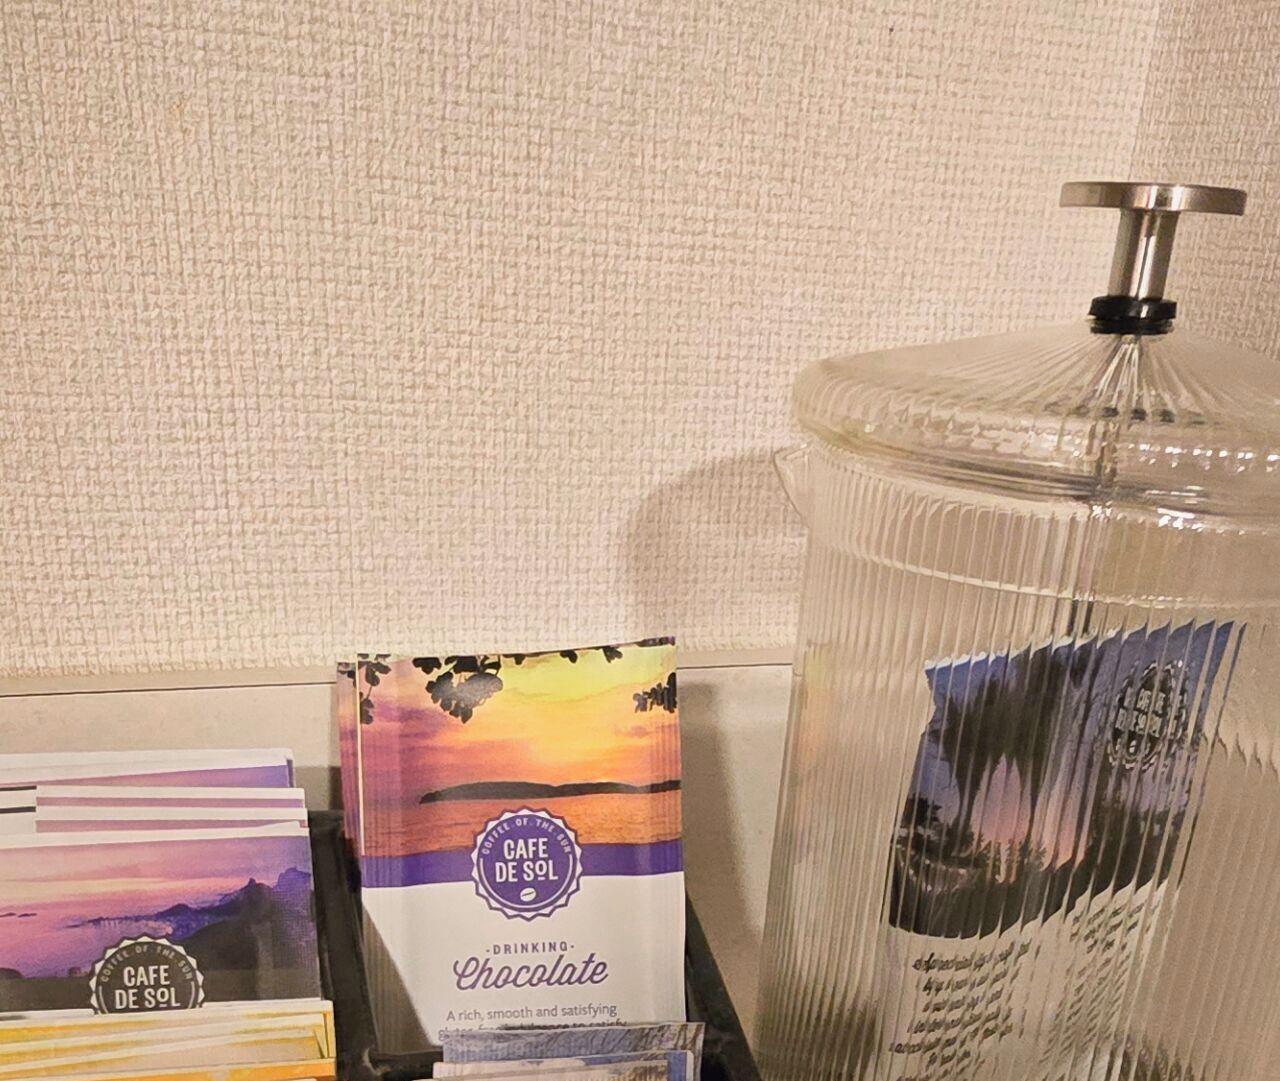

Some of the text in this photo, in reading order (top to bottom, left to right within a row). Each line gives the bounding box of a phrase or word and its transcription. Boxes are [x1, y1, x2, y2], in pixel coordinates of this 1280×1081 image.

[515, 818, 529, 827] OF
[535, 818, 555, 832] THE
[503, 837, 548, 860] CAFE
[495, 859, 558, 883] DE SOL
[123, 965, 171, 987] CAFE
[453, 952, 609, 991] Chocolate
[114, 987, 181, 1009] DE SOL
[446, 1002, 618, 1022] A rich, smooth and satisfying
